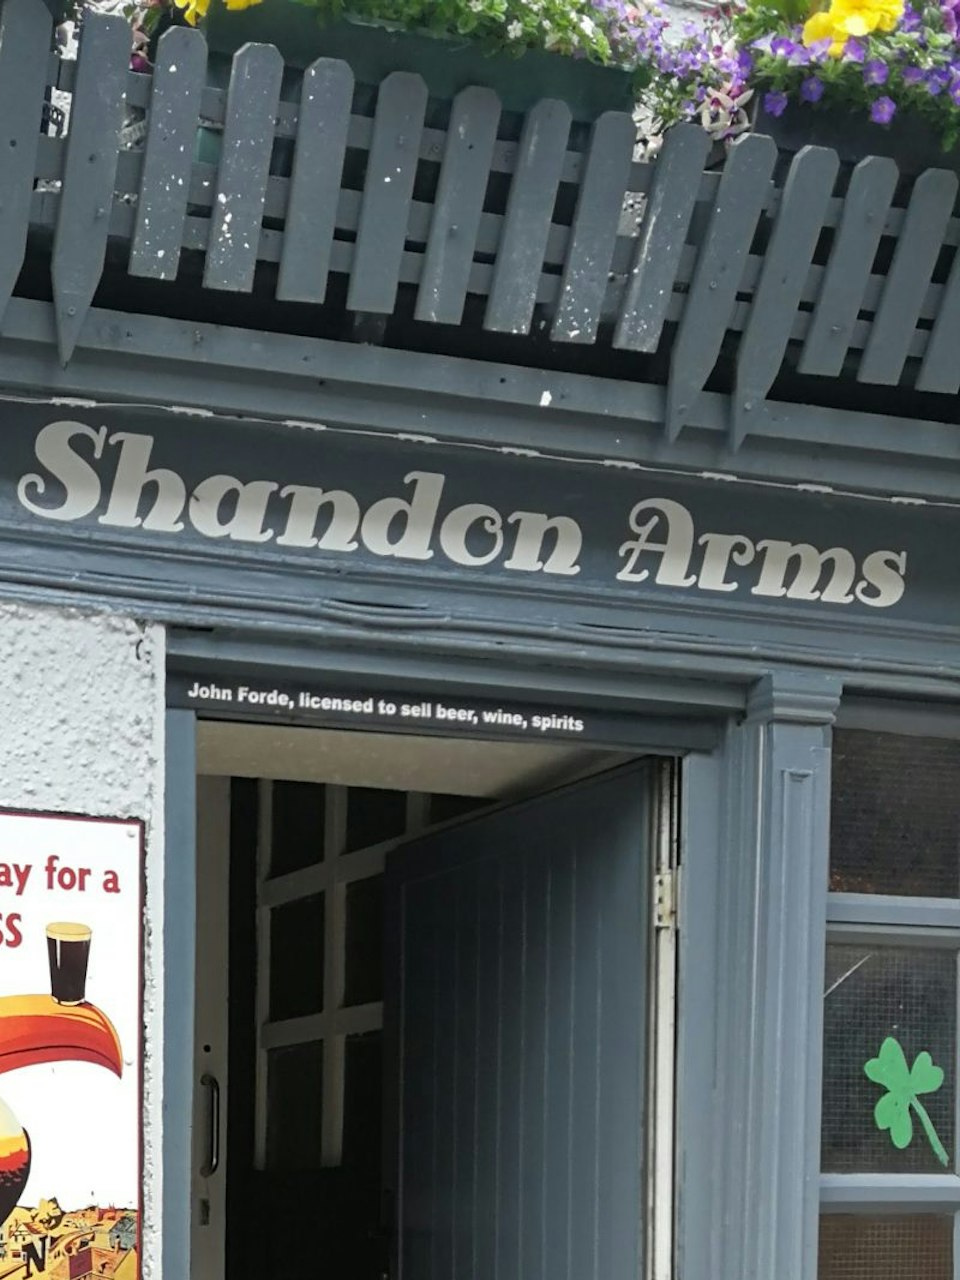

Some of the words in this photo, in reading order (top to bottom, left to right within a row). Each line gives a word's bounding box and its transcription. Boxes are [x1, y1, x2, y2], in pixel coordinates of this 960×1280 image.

[16, 420, 584, 576] Shandon
[615, 497, 908, 608] Arms
[188, 682, 232, 700] John
[238, 686, 294, 709] Forde,
[299, 692, 373, 713] licensed
[377, 700, 396, 715] to
[401, 702, 431, 718] sell
[436, 704, 478, 725] beer,
[483, 709, 528, 729] wine,
[532, 714, 584, 731] spirits
[44, 855, 92, 892] for
[102, 870, 121, 893] a
